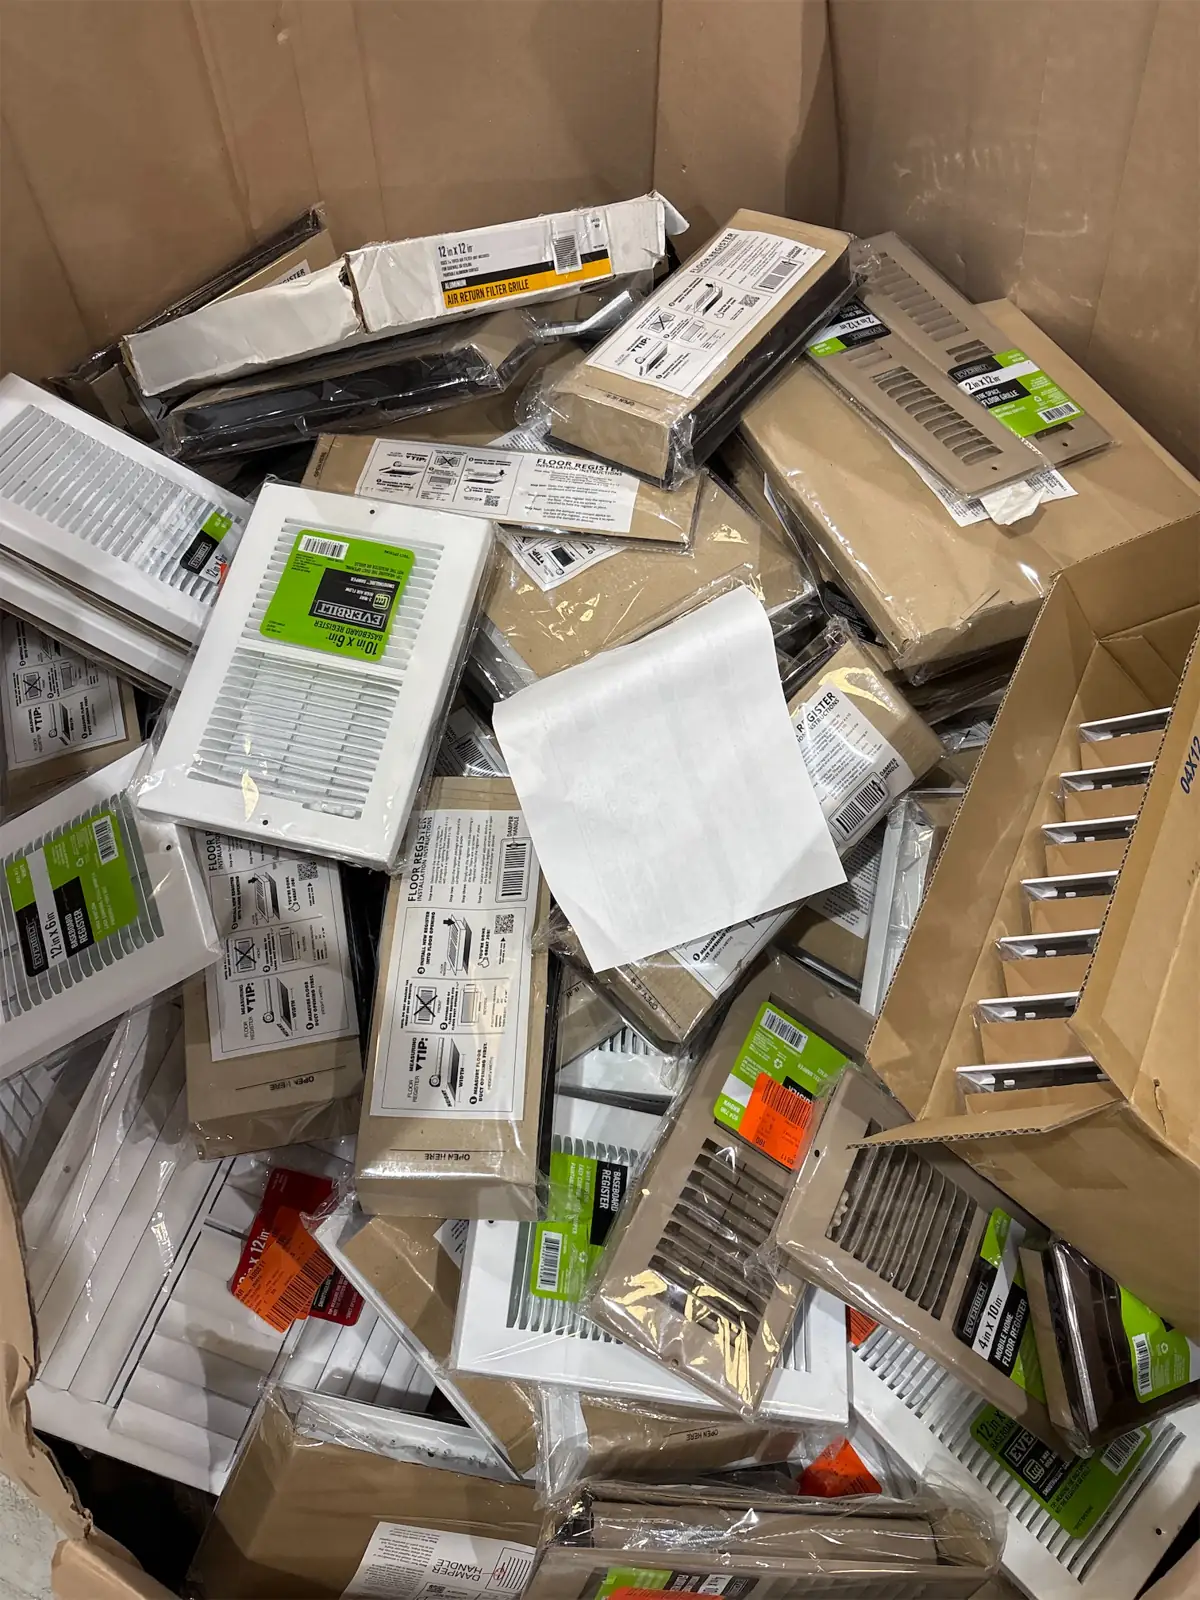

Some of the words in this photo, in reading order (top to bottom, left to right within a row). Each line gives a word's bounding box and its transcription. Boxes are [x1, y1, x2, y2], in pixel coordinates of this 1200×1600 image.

[689, 252, 711, 275] FLOOR
[710, 232, 736, 260] REGISTER
[445, 292, 458, 305] AIR
[458, 287, 485, 302] RETURN
[484, 283, 507, 297] FILTER
[507, 278, 529, 292] GRILLE
[633, 334, 651, 351] TIP:
[964, 378, 979, 391] 2in
[982, 372, 1000, 385] 12in
[985, 387, 1000, 397] SPACE
[981, 395, 999, 406] FLOOR
[998, 389, 1018, 401] GRILLE
[536, 458, 571, 467] FLOOR
[530, 547, 544, 561] TIP:
[316, 602, 382, 625] EVERBILT
[313, 619, 345, 632] REGISTER
[345, 626, 383, 641] BASEBOARD
[355, 638, 378, 655] 10in
[31, 706, 43, 725] TIP:
[879, 757, 897, 777] DAMPER
[883, 762, 900, 781] HANDLE
[413, 816, 426, 864] REGISTER
[208, 838, 218, 871] FLOOR
[416, 859, 426, 901] INSTALLATION
[422, 816, 432, 858] INSTRUCTIONS
[407, 866, 420, 901] FLOOR
[62, 913, 80, 948] BASEBOARD
[71, 907, 90, 943] REGISTER
[25, 922, 44, 964] EVERBILT
[46, 936, 63, 958] 12in
[698, 933, 717, 956] MEASURE
[708, 931, 726, 953] OPENING
[236, 984, 247, 1015] MEASURING
[243, 982, 256, 1005] TIP:
[310, 989, 318, 1012] OPENING
[305, 998, 313, 1021] MEASURE
[408, 1036, 417, 1071] MEASURING
[415, 1036, 428, 1063] TIP:
[472, 1068, 480, 1094] MEASURE
[478, 1059, 487, 1085] OPENING
[406, 1079, 414, 1098] FLOOR
[411, 1074, 420, 1102] REGISTER
[424, 1152, 446, 1162] HERE
[448, 1152, 471, 1161] OPEN
[598, 1169, 612, 1209] REGISTER
[608, 1170, 622, 1211] BASEBOARD
[962, 1284, 989, 1332] EVERBILT
[1006, 1297, 1031, 1338] REGISTER
[975, 1330, 991, 1350] 4in
[986, 1295, 1004, 1319] 10in
[991, 1332, 1009, 1360] MOBILE
[1000, 1311, 1015, 1334] HOME
[999, 1337, 1018, 1366] FLOOR
[975, 1414, 1002, 1441] 12in
[431, 1565, 481, 1581] DAMPER
[435, 1558, 483, 1572] HANDLE
